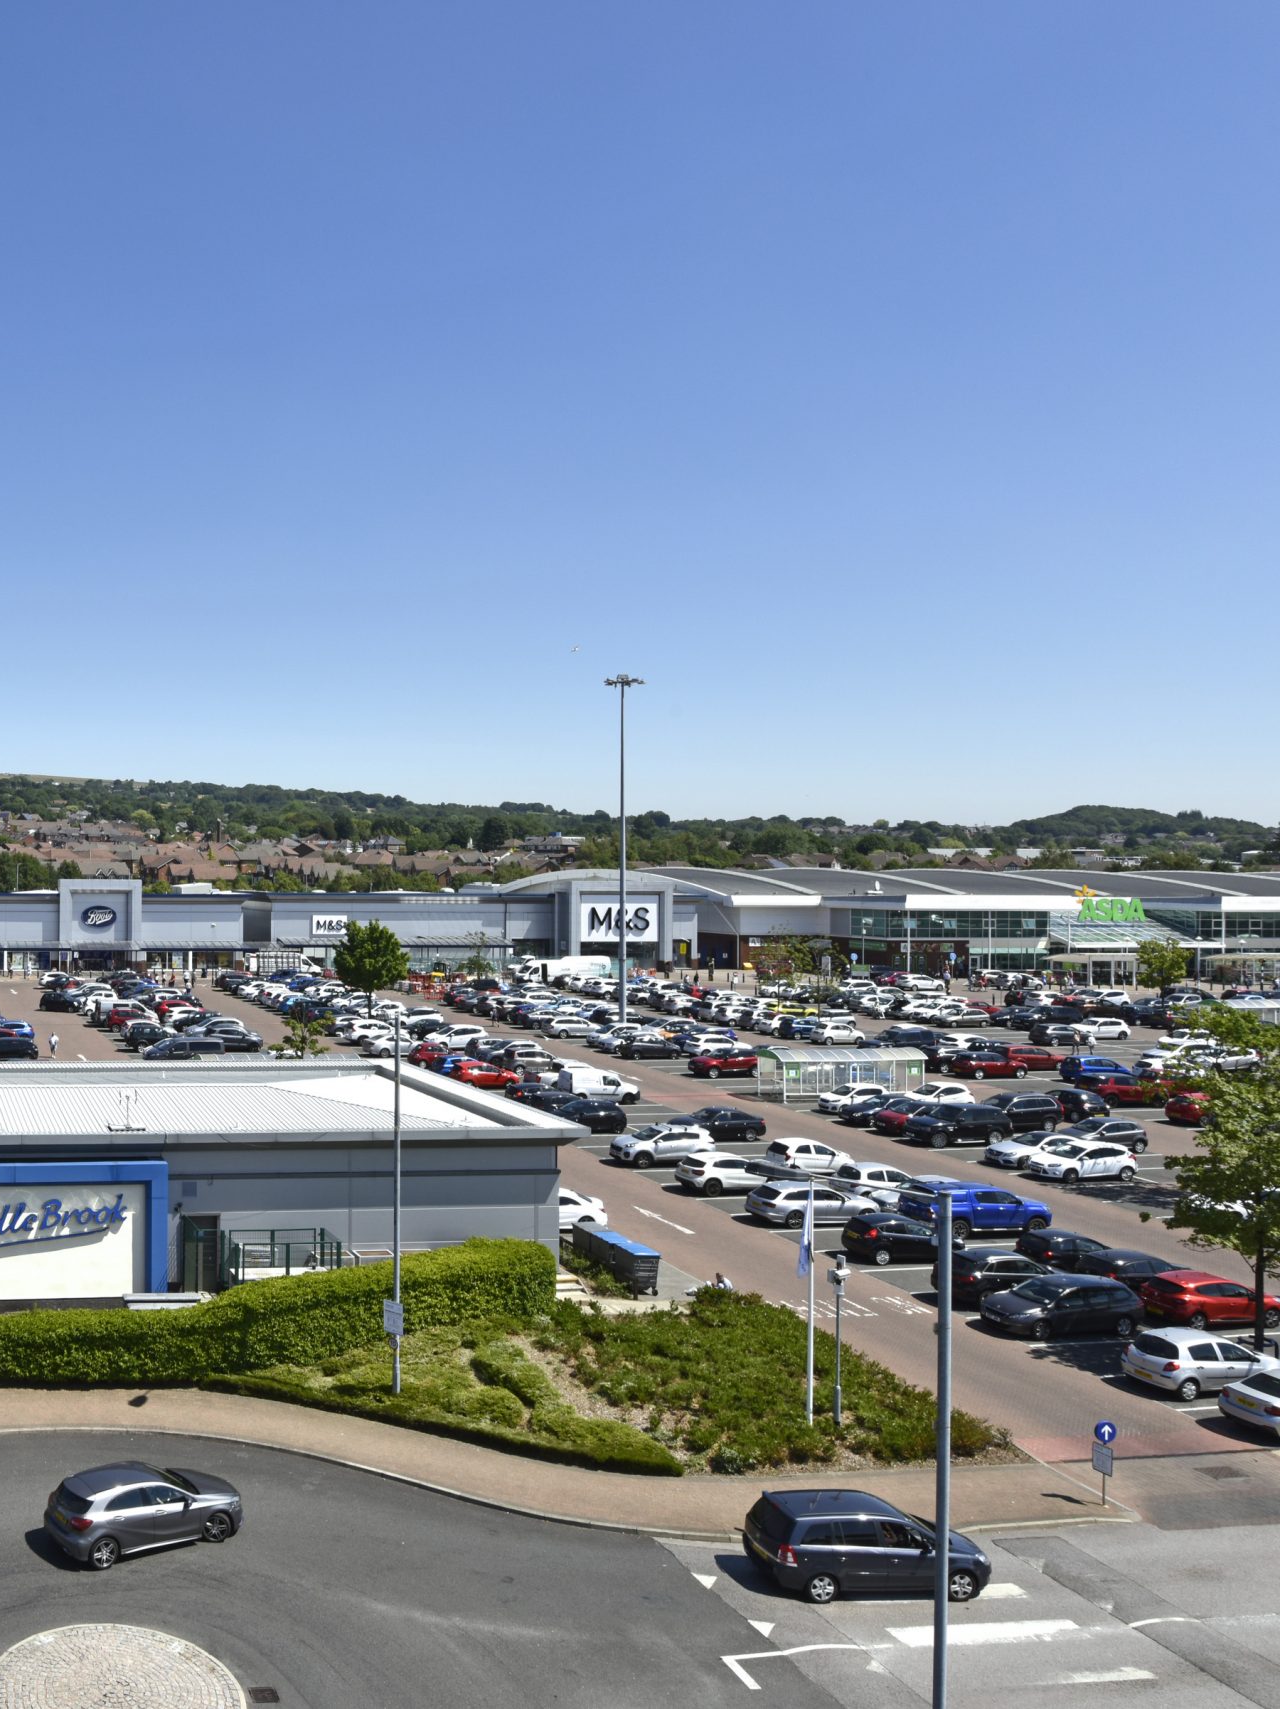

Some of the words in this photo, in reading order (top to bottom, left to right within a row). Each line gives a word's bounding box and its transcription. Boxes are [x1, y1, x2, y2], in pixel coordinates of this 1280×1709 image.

[85, 909, 113, 925] Boots
[591, 907, 650, 931] M&S
[1078, 898, 1146, 922] ASDA
[316, 919, 344, 931] M&S
